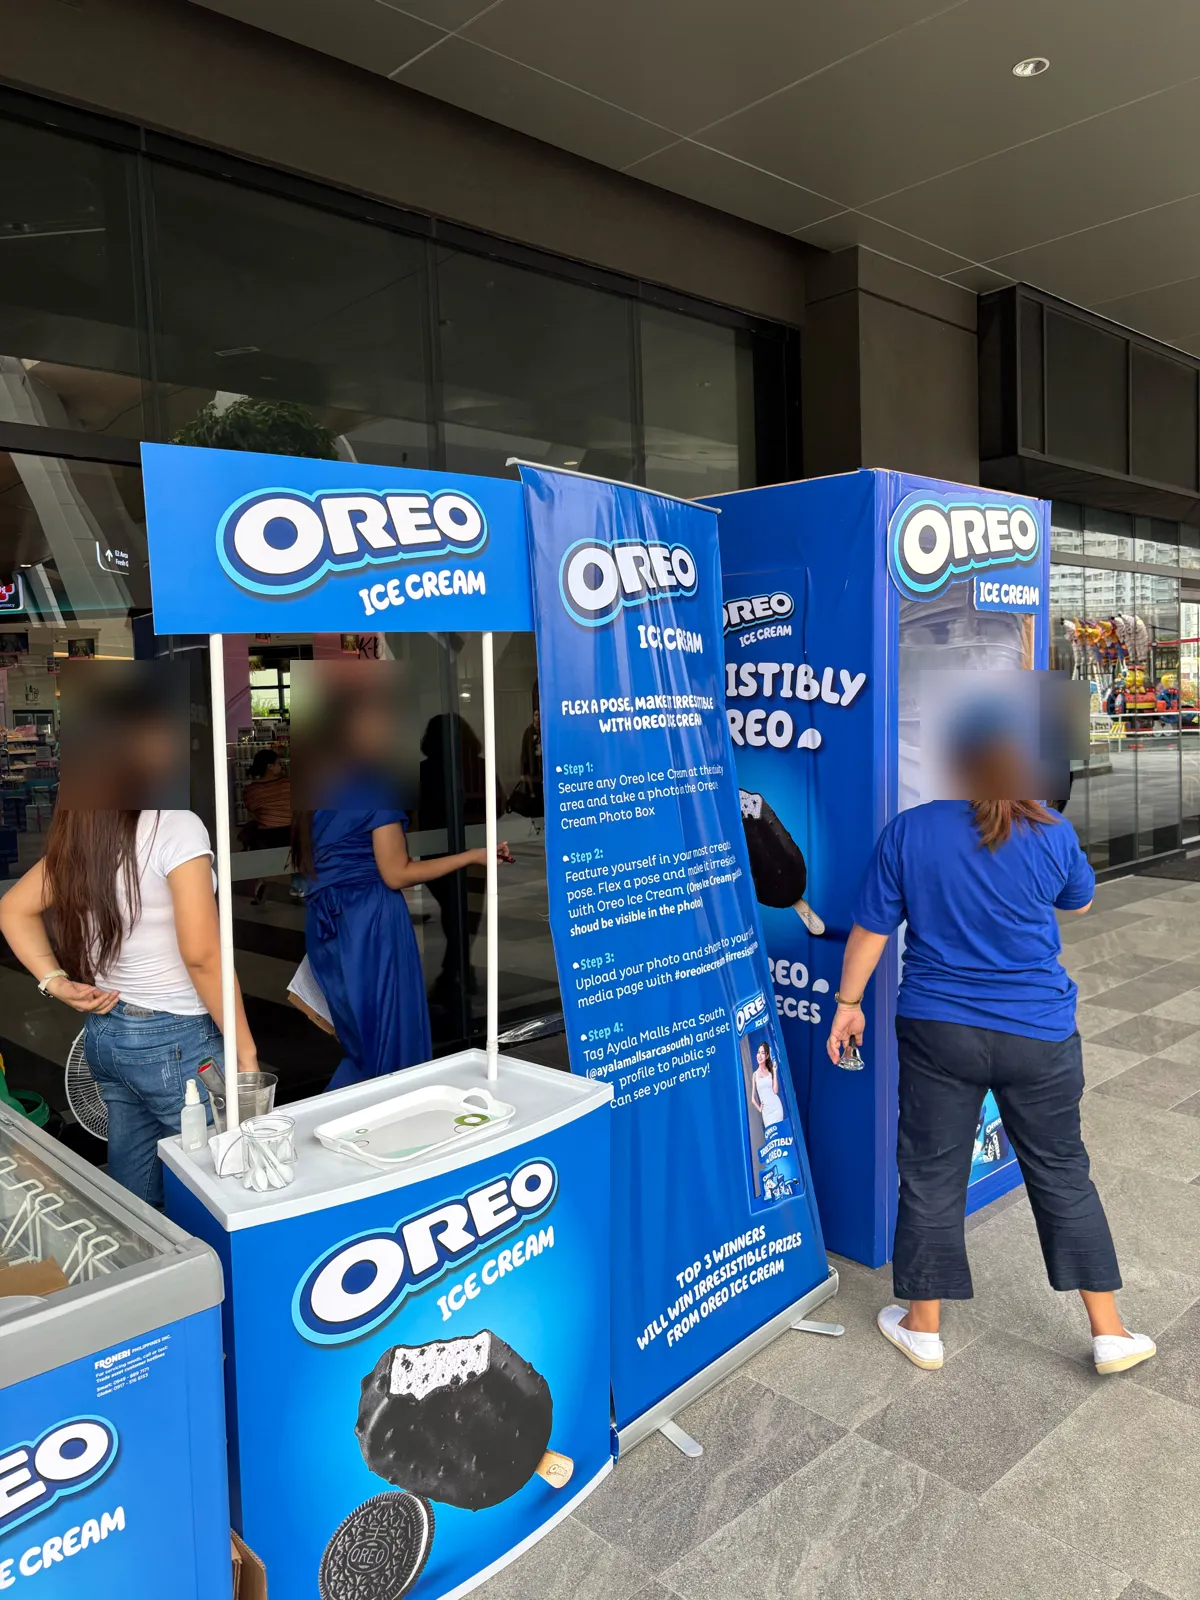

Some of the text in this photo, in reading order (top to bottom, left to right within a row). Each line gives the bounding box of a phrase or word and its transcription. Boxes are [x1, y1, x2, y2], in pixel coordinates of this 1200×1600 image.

[234, 495, 482, 575] OREO
[903, 509, 1036, 575] OREO
[358, 569, 486, 616] ICE CREAM
[568, 546, 696, 610] OREO
[979, 581, 1040, 606] ICE CREAM
[723, 593, 792, 628] REO
[739, 625, 792, 648] ICE CREAM
[725, 662, 867, 707] ISTIBLY
[562, 699, 589, 716] FLEX
[591, 699, 598, 713] A
[600, 697, 634, 713] POSE,
[599, 716, 632, 734] WITH
[633, 714, 666, 730] OREO
[725, 709, 793, 748] REO
[558, 780, 594, 794] Secure
[596, 777, 617, 791] any
[619, 773, 645, 786] Oreo
[647, 771, 665, 783] Ice
[688, 766, 698, 777] at
[563, 761, 594, 777] Step 1:
[559, 798, 585, 813] area
[586, 794, 608, 808] and
[610, 790, 636, 805] take
[638, 789, 646, 801] a
[647, 785, 680, 802] photo
[560, 805, 656, 830] Cream Photo Box
[565, 866, 610, 883] Feature
[611, 854, 658, 877] yourself
[659, 852, 671, 865] in
[673, 851, 692, 865] your
[570, 848, 604, 864] Step 2:
[566, 887, 596, 904] pose.
[598, 878, 622, 895] Flex
[623, 879, 632, 890] a
[634, 873, 661, 889] pose
[663, 866, 687, 881] and
[568, 901, 595, 919] with
[597, 897, 625, 913] Oreo
[627, 893, 644, 906] Ice
[645, 885, 685, 901] Cream
[709, 873, 732, 886] Cream
[570, 918, 600, 937] shoud
[601, 914, 614, 929] be
[615, 909, 646, 928] visible
[648, 906, 657, 918] in
[659, 901, 676, 916] the
[575, 970, 618, 990] Upload
[619, 964, 645, 981] your
[646, 954, 680, 972] photo
[682, 948, 703, 962] and
[721, 938, 730, 948] to
[580, 952, 615, 971] Step 3:
[577, 990, 614, 1009] media
[615, 983, 644, 999] page
[646, 972, 673, 988] with
[584, 1006, 725, 1063] Tag Ayala Malls Arca South
[588, 1021, 624, 1042] Step 4:
[695, 1028, 715, 1043] and
[716, 1021, 730, 1036] set
[619, 1044, 716, 1090] profile to Public so
[610, 1063, 711, 1110] can see your entry!
[310, 1163, 553, 1323] OREO
[675, 1225, 766, 1289] TOP 3 WINNERS
[436, 1225, 555, 1322] ICE CREAM
[636, 1232, 802, 1350] WILL WIN IRRESISTIBLE PRIZES
[666, 1259, 785, 1347] FROM OREO ICE CREAM
[94, 1349, 131, 1370] FRONERI
[19, 1506, 126, 1577] CREAM
[351, 1547, 385, 1565] OREO
